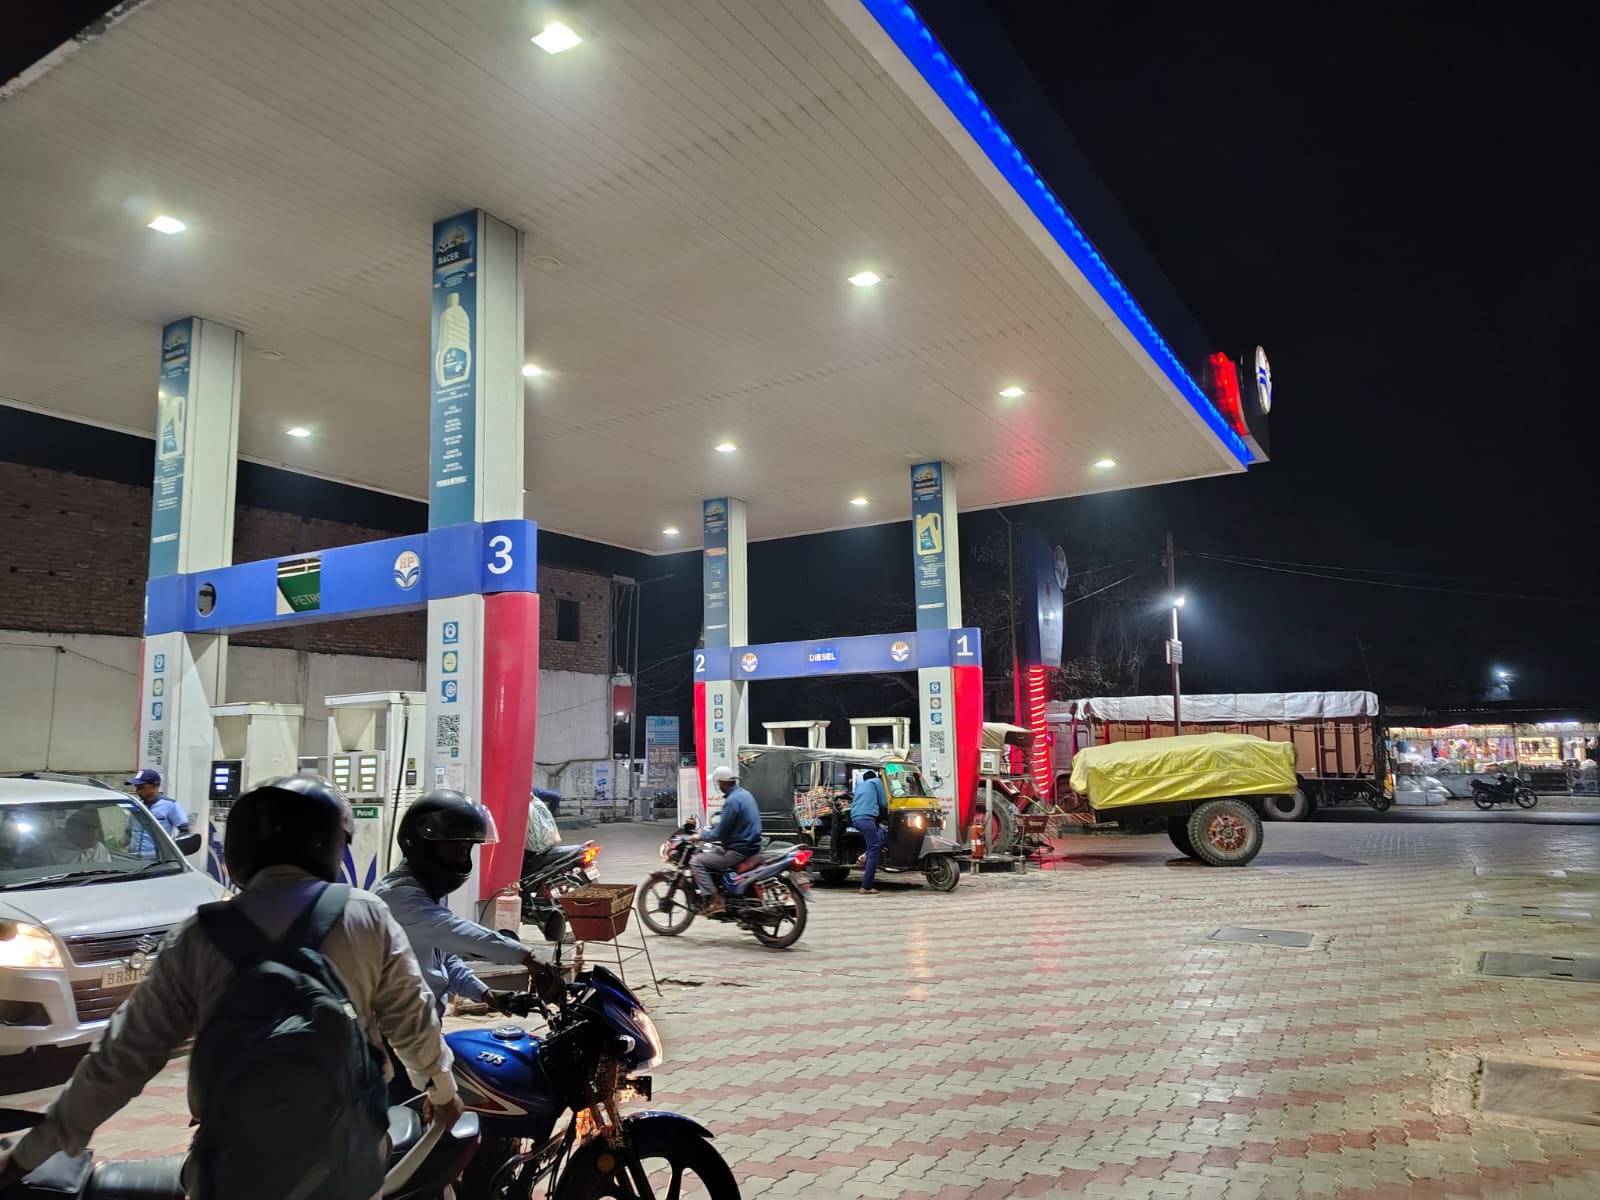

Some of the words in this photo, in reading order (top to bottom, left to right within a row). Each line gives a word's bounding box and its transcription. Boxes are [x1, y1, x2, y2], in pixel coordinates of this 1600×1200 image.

[438, 252, 460, 264] RACER
[487, 535, 514, 574] 3
[399, 555, 414, 570] HP
[895, 643, 906, 651] HP
[957, 634, 974, 657] 1
[695, 653, 706, 673] 2
[745, 654, 755, 662] HP
[809, 652, 836, 662] DIESEL
[356, 809, 374, 817] Petrol
[477, 1051, 505, 1065] TVS
